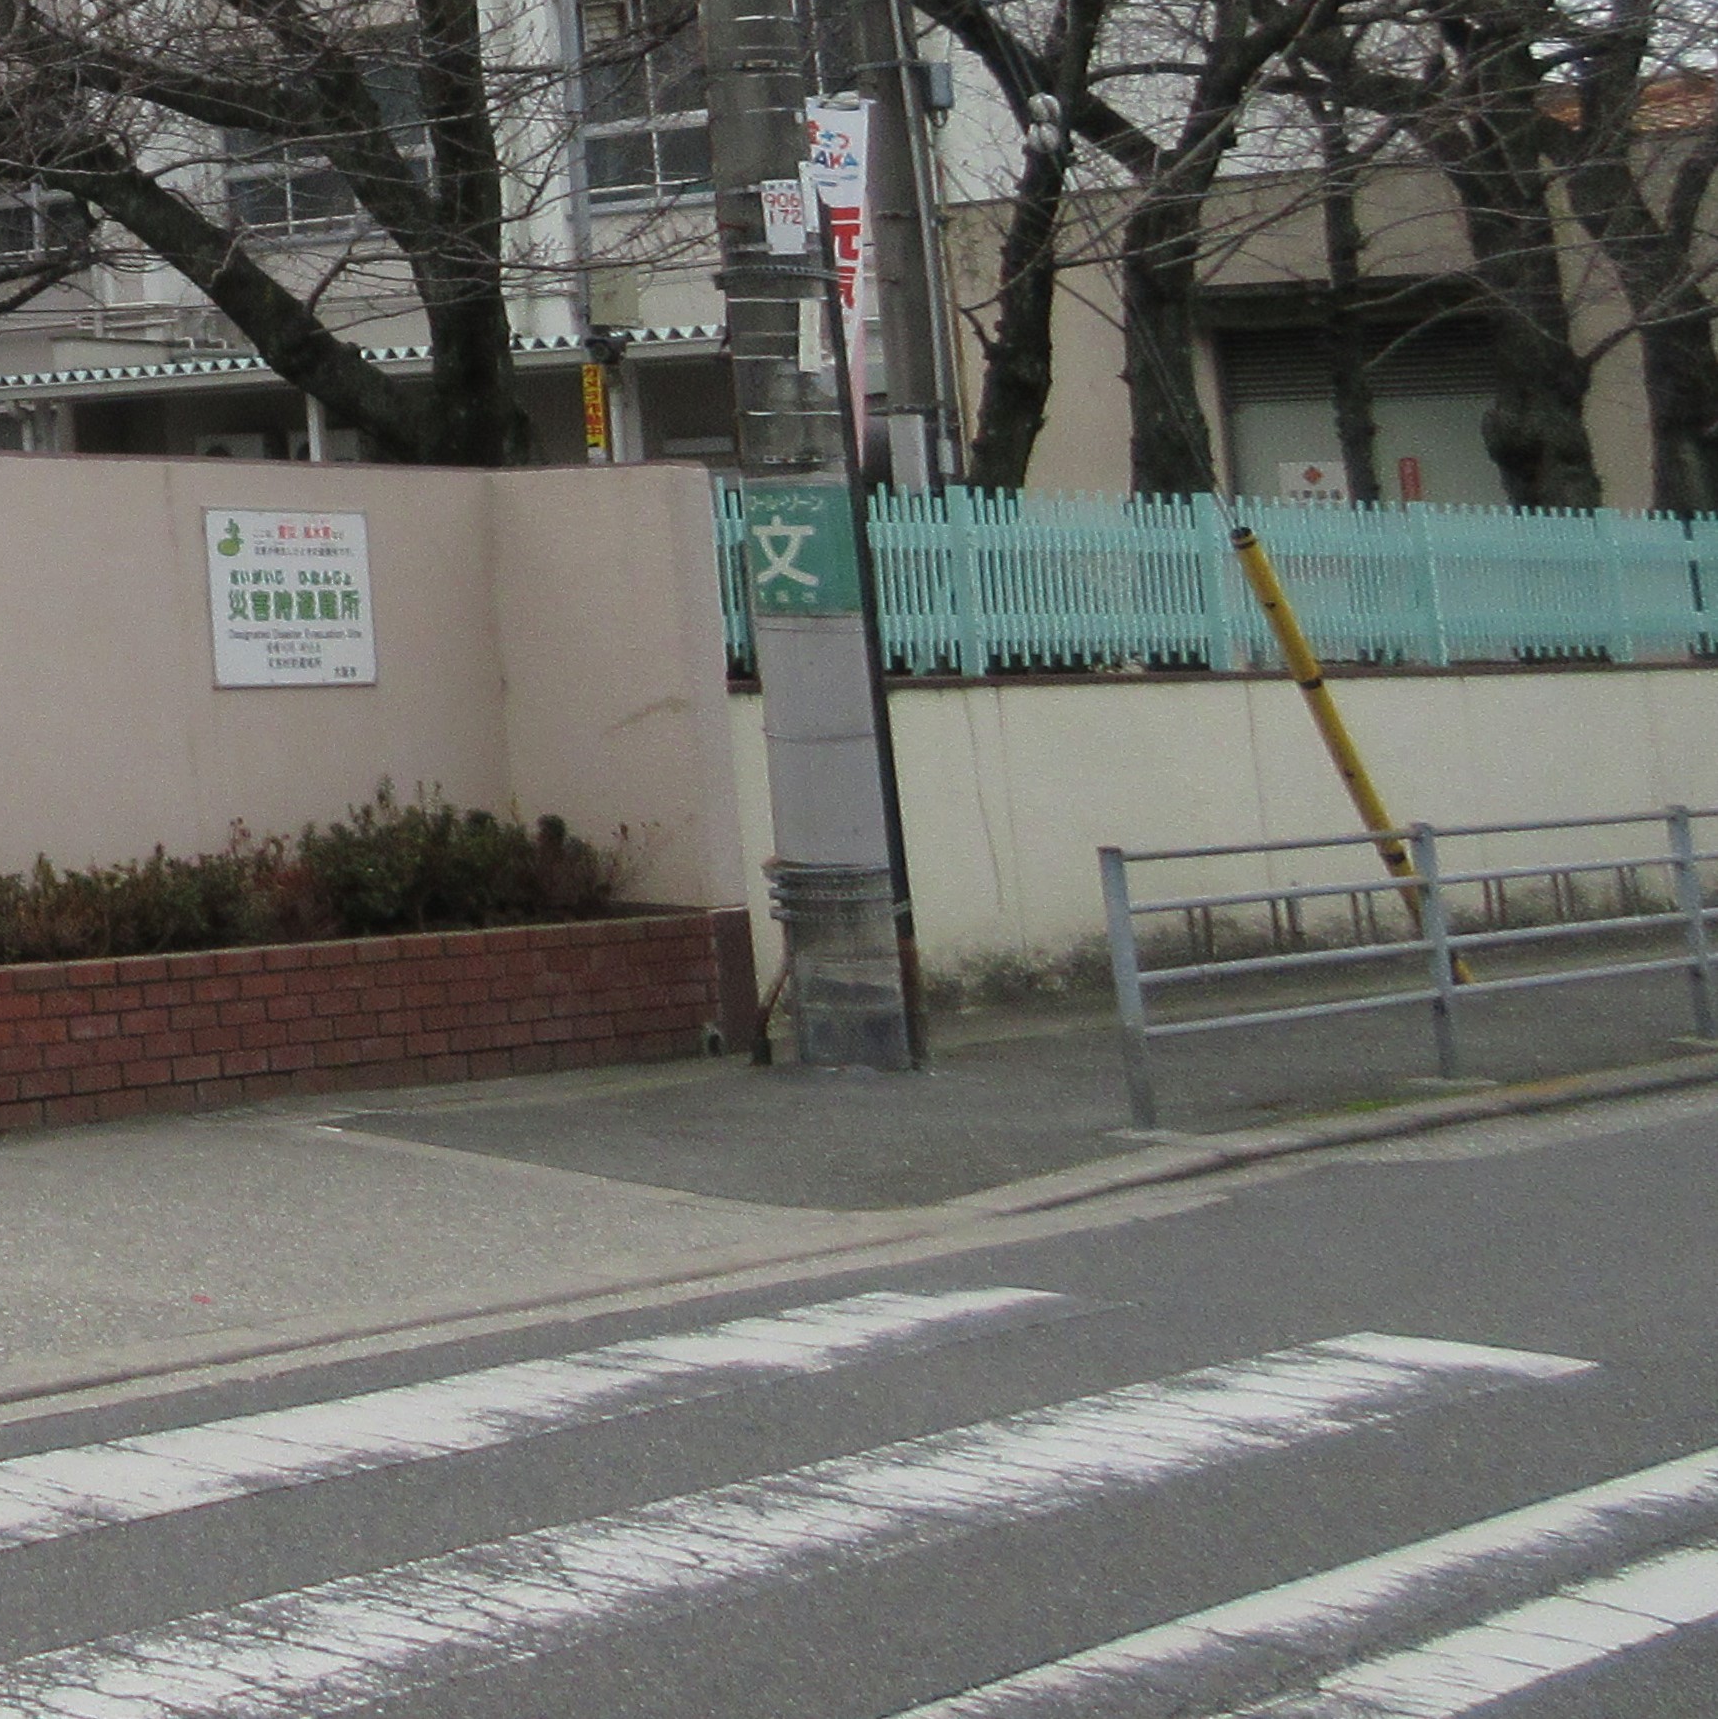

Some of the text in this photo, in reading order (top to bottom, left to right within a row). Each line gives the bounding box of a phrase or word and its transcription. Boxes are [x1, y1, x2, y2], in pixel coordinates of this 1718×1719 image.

[764, 193, 801, 208] 906
[769, 209, 803, 225] 172
[752, 515, 820, 586] 文
[228, 589, 359, 621] 災害時避難所
